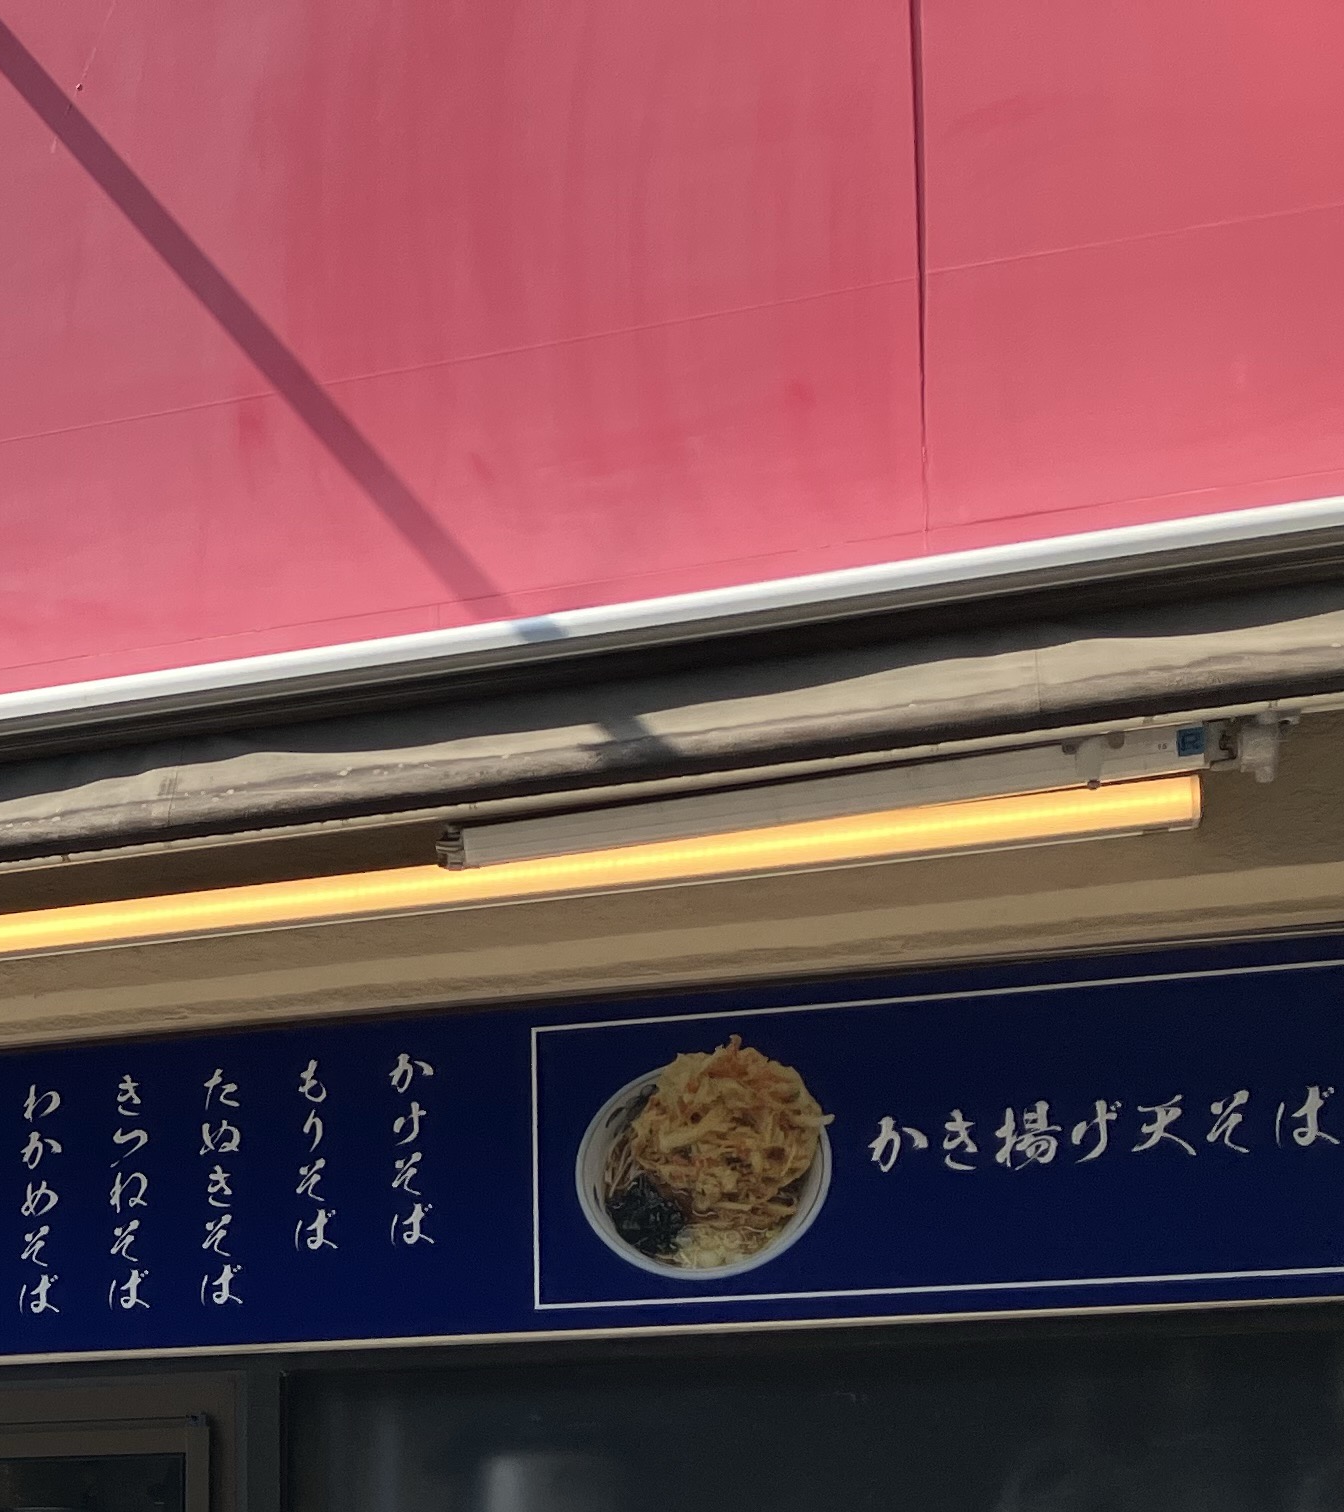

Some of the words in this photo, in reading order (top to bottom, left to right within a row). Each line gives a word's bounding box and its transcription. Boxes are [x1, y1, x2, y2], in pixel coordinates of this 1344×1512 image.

[20, 1085, 61, 1313] わかめそば
[109, 1075, 150, 1308] きつねそば
[200, 1069, 243, 1304] たぬきそば
[295, 1060, 338, 1249] もりそば
[389, 1054, 434, 1244] かけそば
[868, 1085, 1341, 1173] かき揚げ天そば
